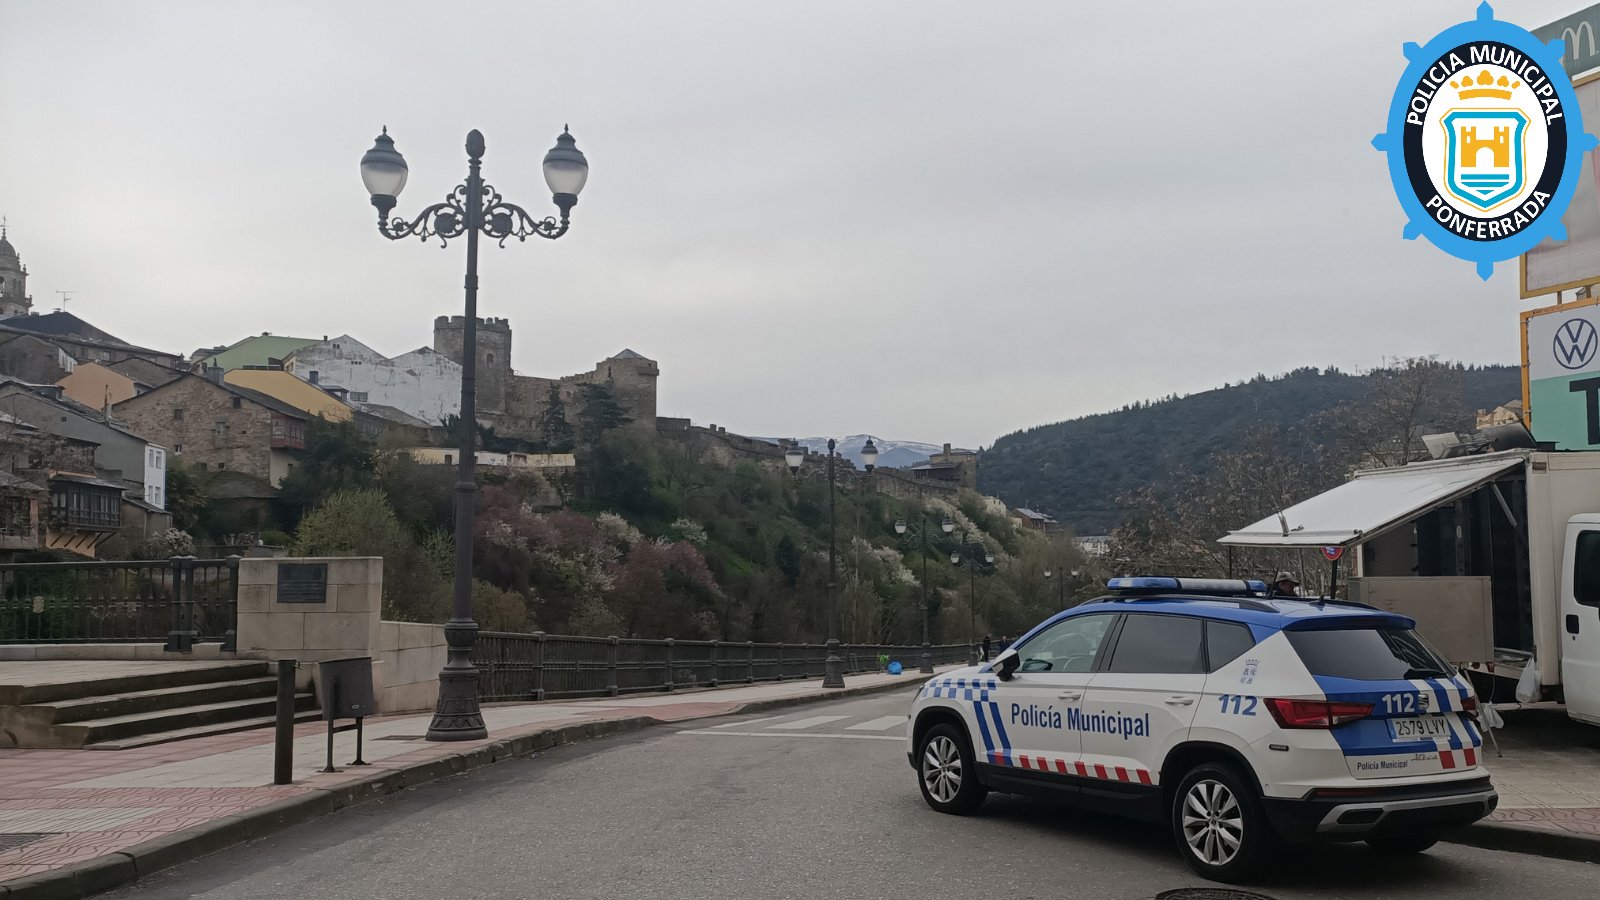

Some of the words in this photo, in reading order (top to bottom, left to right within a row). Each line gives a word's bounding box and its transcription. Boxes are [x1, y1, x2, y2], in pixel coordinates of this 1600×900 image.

[1218, 694, 1257, 717] 112
[1381, 692, 1415, 714] 112
[1011, 702, 1062, 730] Policía
[1067, 707, 1150, 740] Municipal
[1395, 720, 1425, 736] 2579
[1425, 717, 1447, 735] LVY
[1357, 761, 1379, 771] Policía
[1380, 760, 1408, 770] Municipal
